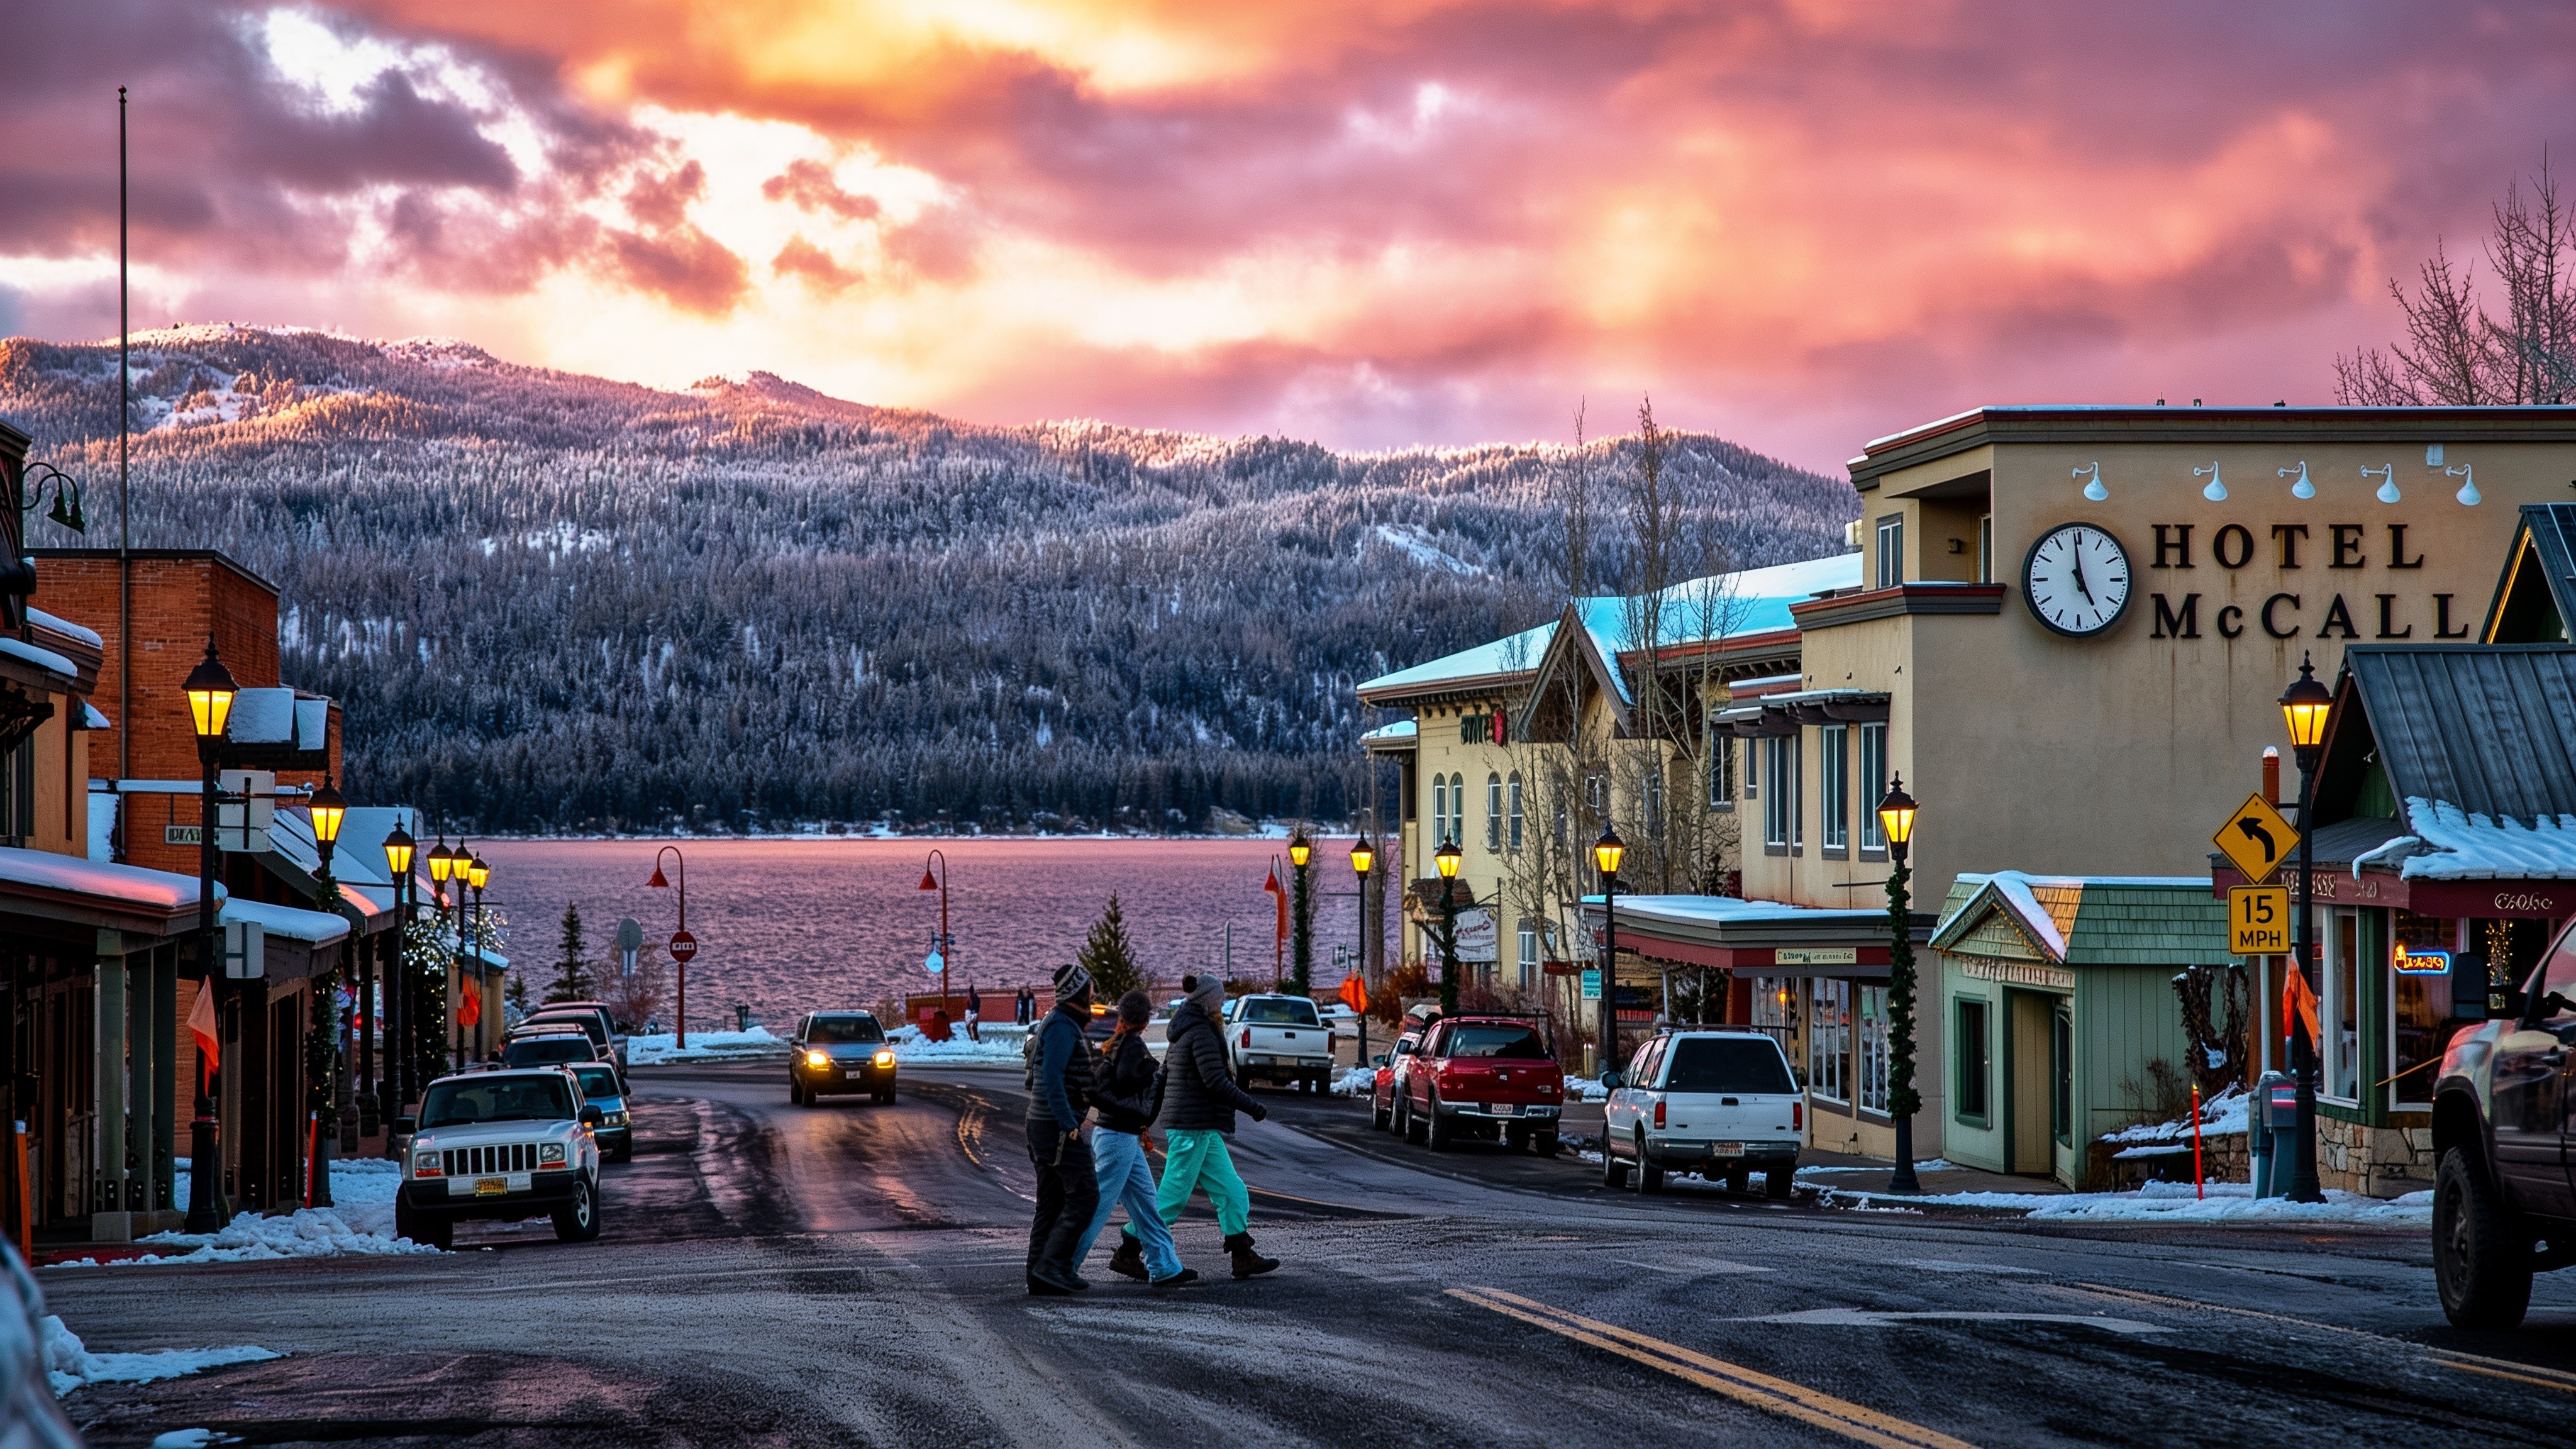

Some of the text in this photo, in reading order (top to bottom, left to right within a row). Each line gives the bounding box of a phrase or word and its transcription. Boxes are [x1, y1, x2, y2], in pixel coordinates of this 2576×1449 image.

[2150, 523, 2424, 569] HOTEL
[2150, 592, 2469, 639] McCALL
[2242, 895, 2273, 924] 15
[2240, 930, 2280, 947] MPH
